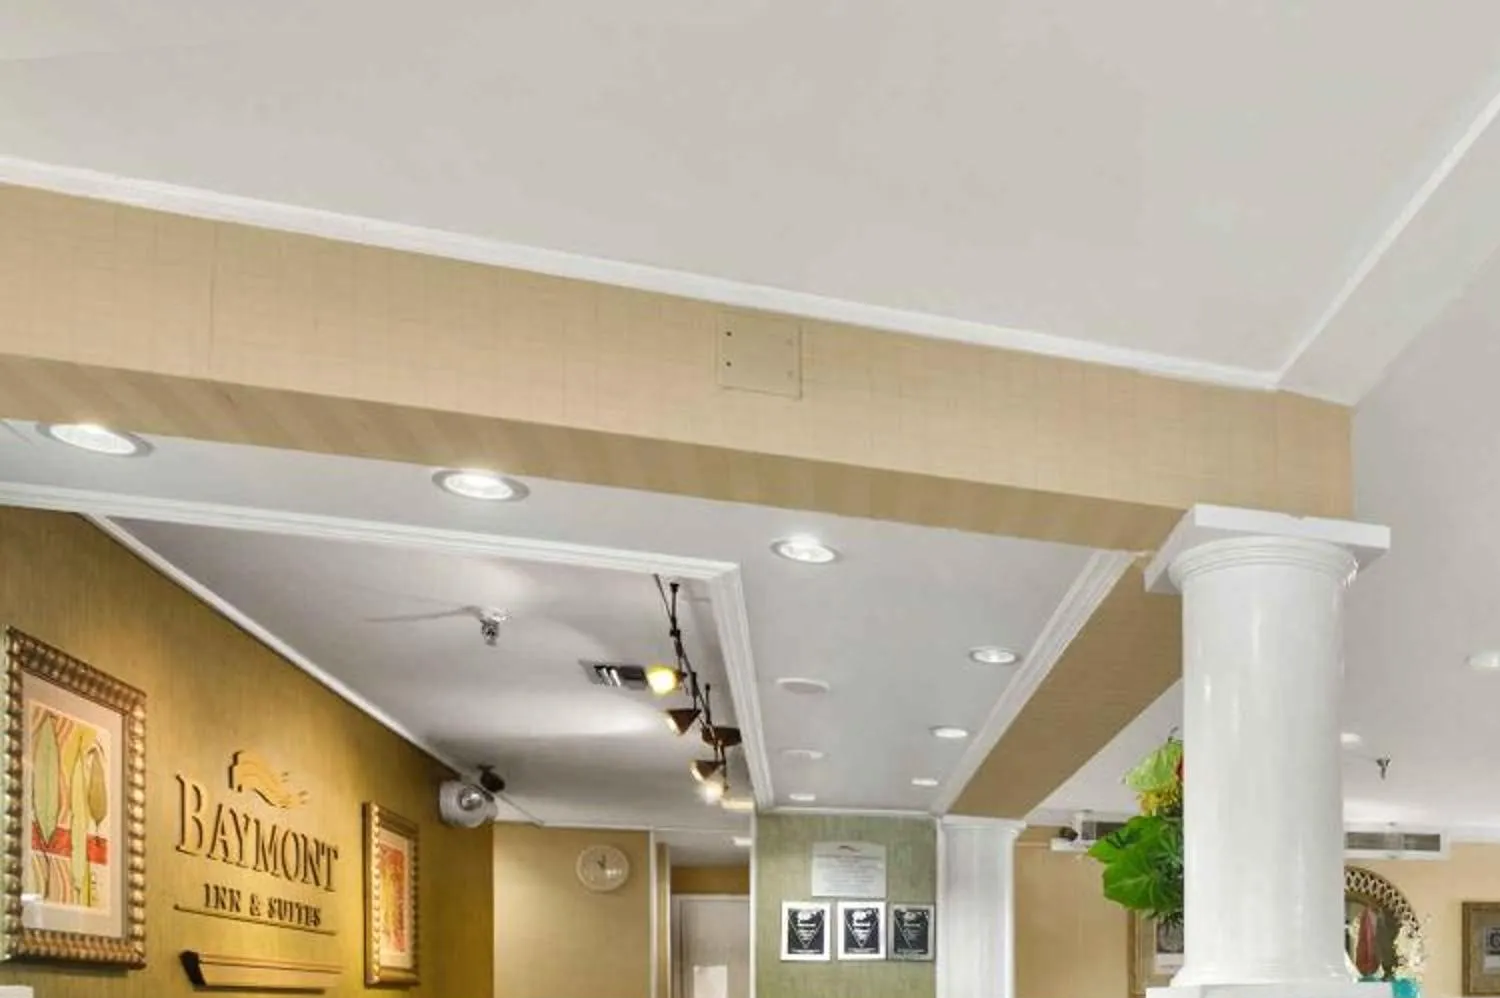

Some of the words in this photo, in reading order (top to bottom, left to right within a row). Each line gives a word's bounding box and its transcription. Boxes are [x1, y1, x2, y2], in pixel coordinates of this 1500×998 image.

[175, 774, 338, 892] BAYMONT
[203, 883, 241, 912] INN
[250, 893, 261, 917] &
[267, 897, 321, 927] SUITES
